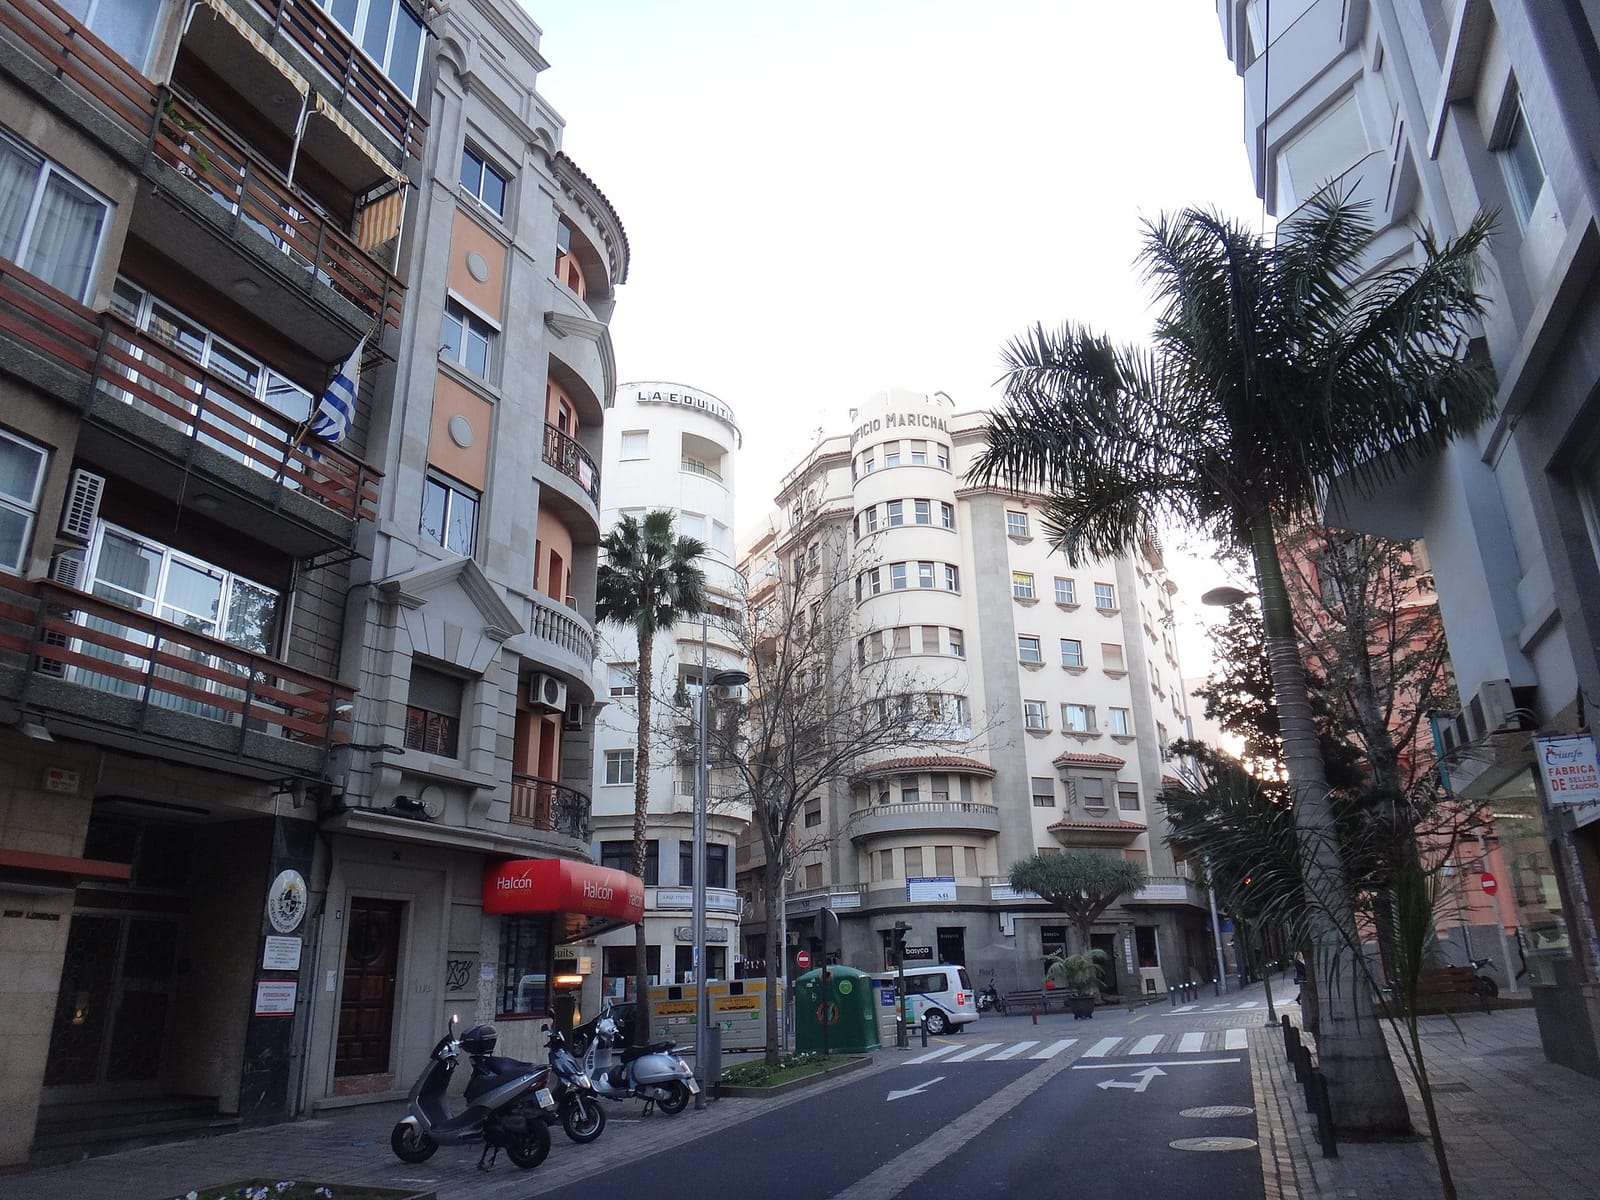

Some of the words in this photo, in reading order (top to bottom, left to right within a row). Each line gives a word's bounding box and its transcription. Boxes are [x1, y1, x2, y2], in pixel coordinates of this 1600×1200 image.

[885, 412, 950, 435] MARICHAL
[1548, 765, 1595, 776] FABRICA
[1569, 775, 1597, 783] SELLOS
[1551, 778, 1567, 791] DE
[496, 868, 532, 889] Halcón
[583, 874, 613, 901] Halcón
